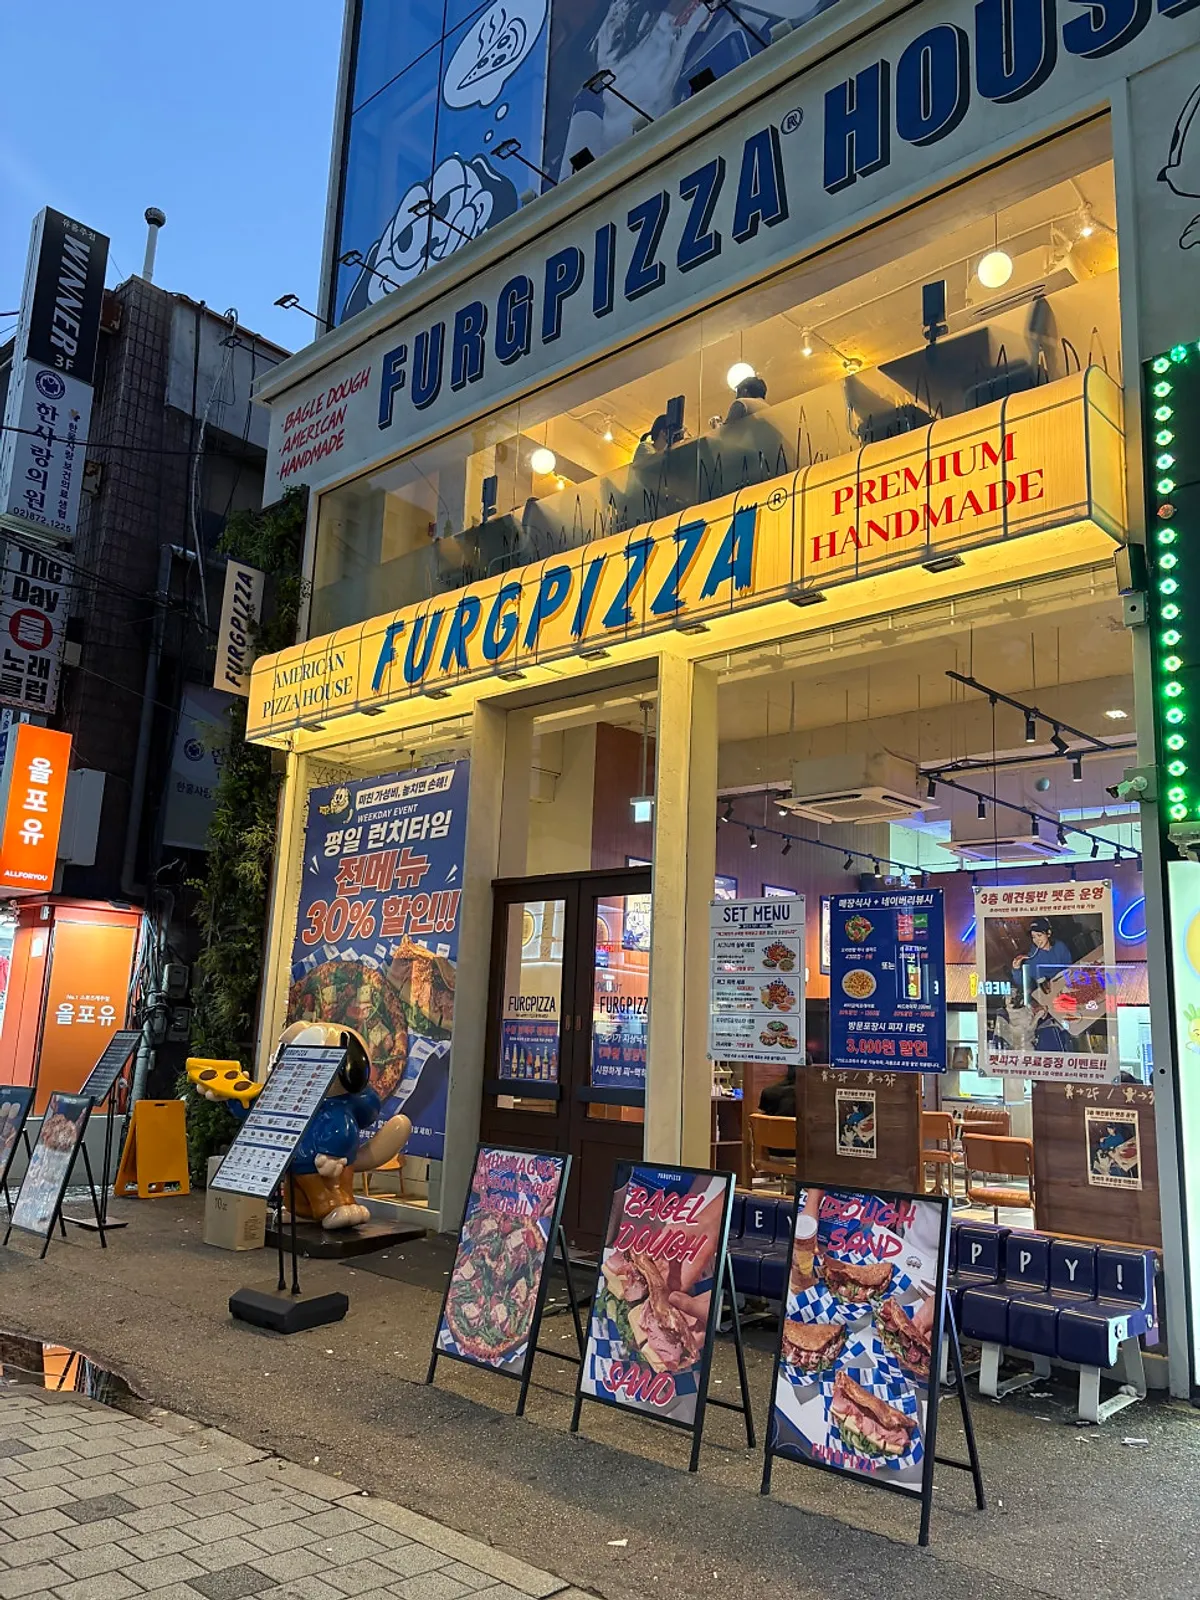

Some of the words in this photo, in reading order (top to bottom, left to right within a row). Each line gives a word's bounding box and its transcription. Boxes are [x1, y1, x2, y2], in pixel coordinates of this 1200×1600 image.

[50, 233, 91, 357] WINNER
[53, 354, 75, 371] 3F
[283, 393, 324, 434] BAGLE
[326, 366, 371, 409] DOUGH
[281, 404, 348, 456] AMERICAN
[23, 402, 60, 513] 한사랑의원
[280, 429, 345, 481] HANDMADE
[830, 432, 1017, 516] PREMIUM
[810, 469, 1044, 563] HANDMADE
[17, 548, 64, 582] The
[11, 576, 60, 613] Day
[224, 570, 254, 688] FURGPIZZA
[2, 648, 51, 680] 노래
[272, 651, 347, 691] AMERICAN
[263, 693, 301, 719] PIZZA
[302, 676, 353, 705] HOUSE
[18, 757, 53, 846] 올포유
[357, 809, 392, 823] WEEKDAY
[393, 804, 418, 817] EVENT
[324, 827, 362, 857] 평일
[367, 810, 452, 849] 런치타임
[4, 869, 48, 882] ALLFORYOU
[334, 847, 431, 898] 전메뉴
[723, 907, 748, 923] SET
[753, 904, 790, 922] MENU
[981, 893, 998, 905] 3층
[1002, 890, 1048, 904] 애견동반
[1051, 888, 1075, 902] 펫존
[1079, 887, 1104, 901] 운영
[302, 896, 377, 946] 30%
[54, 1001, 116, 1026] 올포유
[508, 995, 557, 1013] FURGPIZZA
[599, 996, 649, 1014] FURGPIZZ
[846, 1038, 895, 1056] 3,000원
[899, 1039, 928, 1058] 할인
[989, 1054, 1019, 1066] 펫피자
[1022, 1055, 1064, 1068] 무료증정
[1067, 1057, 1107, 1070] 이벤트!!
[1086, 1087, 1100, 1101] 2F
[624, 1186, 706, 1226] BAGEL
[819, 1195, 917, 1230] DOUGH
[613, 1222, 707, 1264] DOUGH
[827, 1228, 903, 1259] SAND
[603, 1362, 676, 1407] SAND
[811, 1442, 877, 1474] FURGPIZZA
